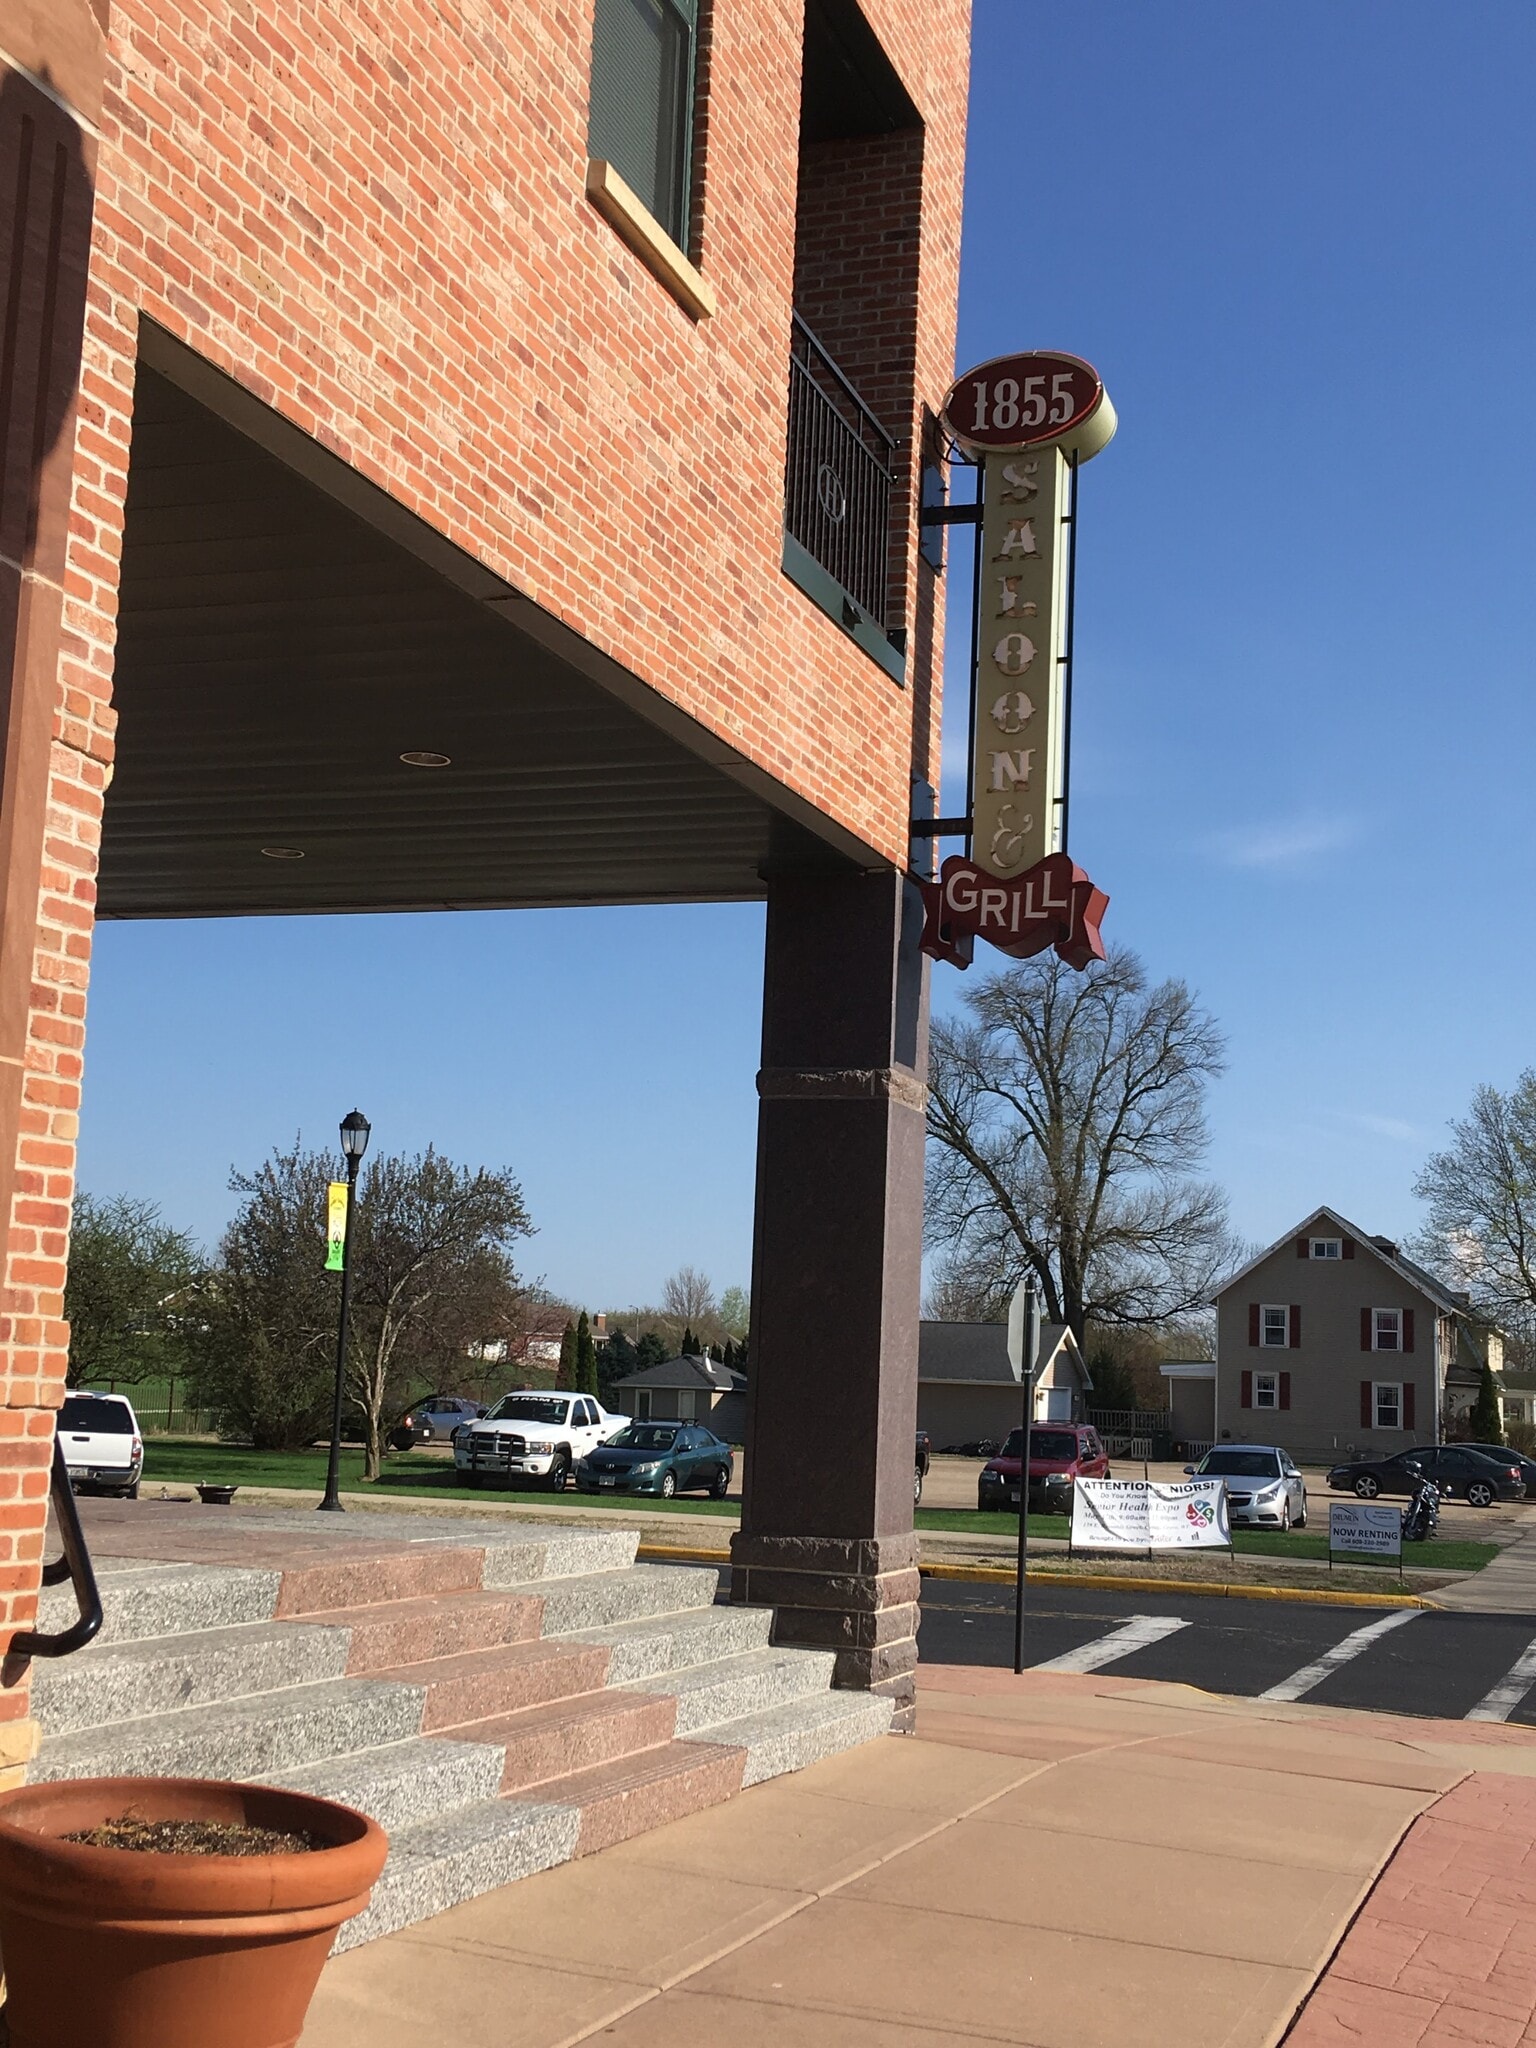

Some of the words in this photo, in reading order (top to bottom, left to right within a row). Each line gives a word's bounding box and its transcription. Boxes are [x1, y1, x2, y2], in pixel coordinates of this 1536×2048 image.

[970, 372, 1075, 431] 1855
[986, 460, 1042, 793] SALOON
[990, 804, 1034, 868] &
[946, 870, 1067, 932] GRILL
[1084, 1481, 1152, 1492] ATTENTION
[1119, 1501, 1152, 1512] Health
[1333, 1528, 1356, 1537] NOW
[1359, 1530, 1398, 1540] RENTING
